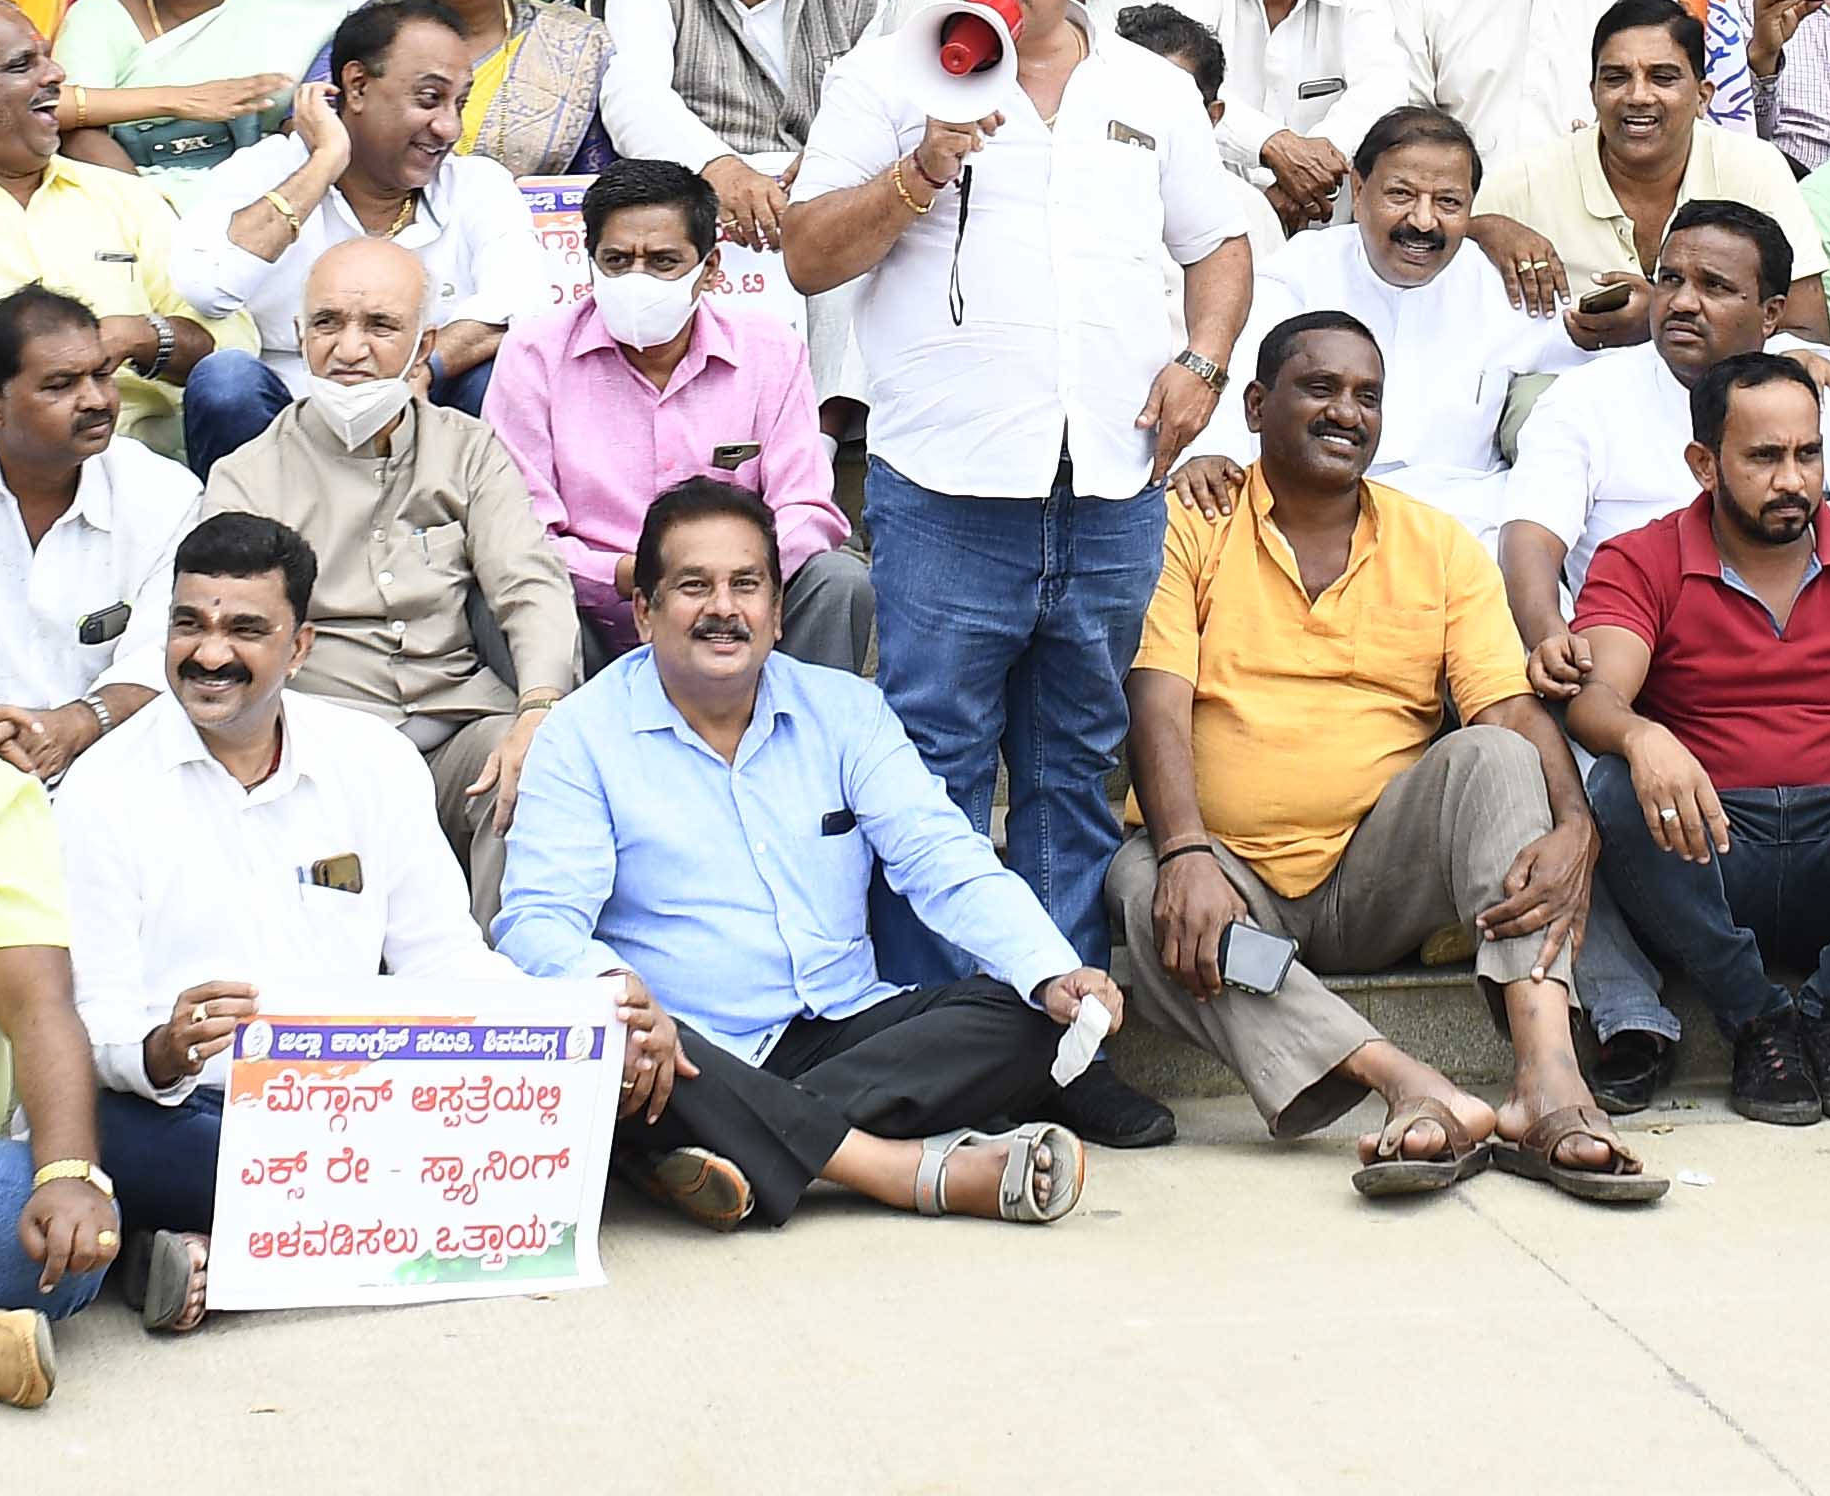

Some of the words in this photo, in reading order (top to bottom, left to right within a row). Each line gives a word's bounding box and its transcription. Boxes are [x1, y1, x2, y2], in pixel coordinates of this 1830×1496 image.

[277, 1030, 323, 1058] ಜಿಲ್ಲಾ
[330, 1027, 411, 1060] ಕಾಂಗ್ರೆಸ್
[482, 1030, 559, 1061] ಶಿವಮೊಗ್ಗ
[266, 1075, 393, 1133] ಮೆಗ್ಗಾನ್
[410, 1075, 562, 1128] ಆಸ್ಪತ್ರೆಯಲ್ಲಿ
[240, 1150, 309, 1201] ಎಕ್ಸ್
[326, 1147, 370, 1184] ರೇ
[421, 1147, 571, 1206] ಸ್ಕ್ಯಾನಿಂಗ್
[434, 1213, 547, 1264] ಒತ್ತಾಯ
